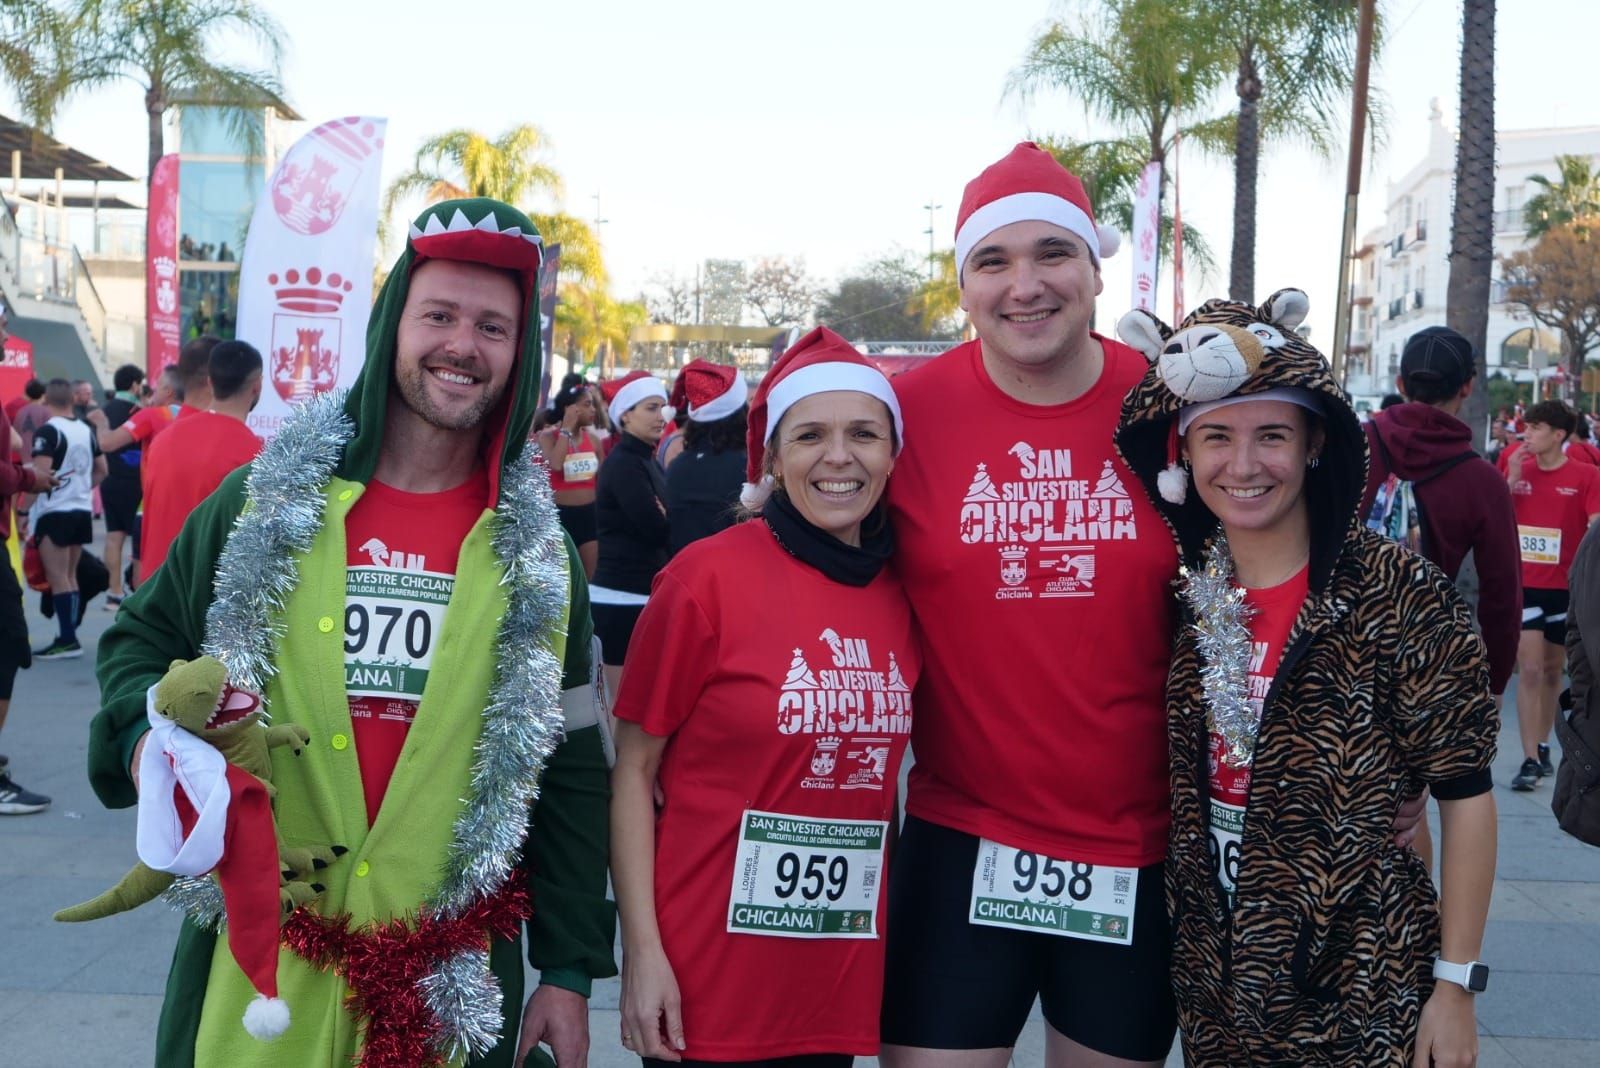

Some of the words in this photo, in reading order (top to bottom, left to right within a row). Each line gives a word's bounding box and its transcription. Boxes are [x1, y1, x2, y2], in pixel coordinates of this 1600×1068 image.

[572, 459, 591, 473] 355
[1019, 449, 1072, 480] SAN
[1001, 480, 1090, 502] SILVESTRE
[960, 498, 1137, 545] CHICLANA
[1522, 536, 1547, 552] 383
[346, 571, 399, 586] ILVESTRE
[357, 584, 377, 594] LOCAL
[377, 586, 386, 595] DE
[386, 587, 419, 598] CARRERAS
[419, 590, 449, 602] POPULARE
[995, 591, 1033, 600] Chiclana
[343, 603, 432, 660] 970
[829, 638, 872, 669] SAN
[344, 668, 393, 687] LANA
[819, 670, 888, 691] SILVESTRE
[800, 780, 836, 790] Chiclana
[749, 816, 775, 831] SAN
[776, 819, 826, 836] SILVESTRE
[827, 825, 881, 839] CHICLANERA
[766, 831, 792, 841] CIRCUITO
[792, 834, 809, 844] LOCAL
[809, 836, 818, 845] DE
[816, 837, 842, 846] CARRERAS
[742, 857, 753, 891] LOURDES
[774, 852, 849, 902] 959
[983, 856, 991, 881] SERGIO
[1012, 849, 1094, 902] 958
[978, 901, 1057, 925] CHICLANA
[1114, 898, 1126, 906] XXL
[735, 907, 814, 929] CHICLANA
